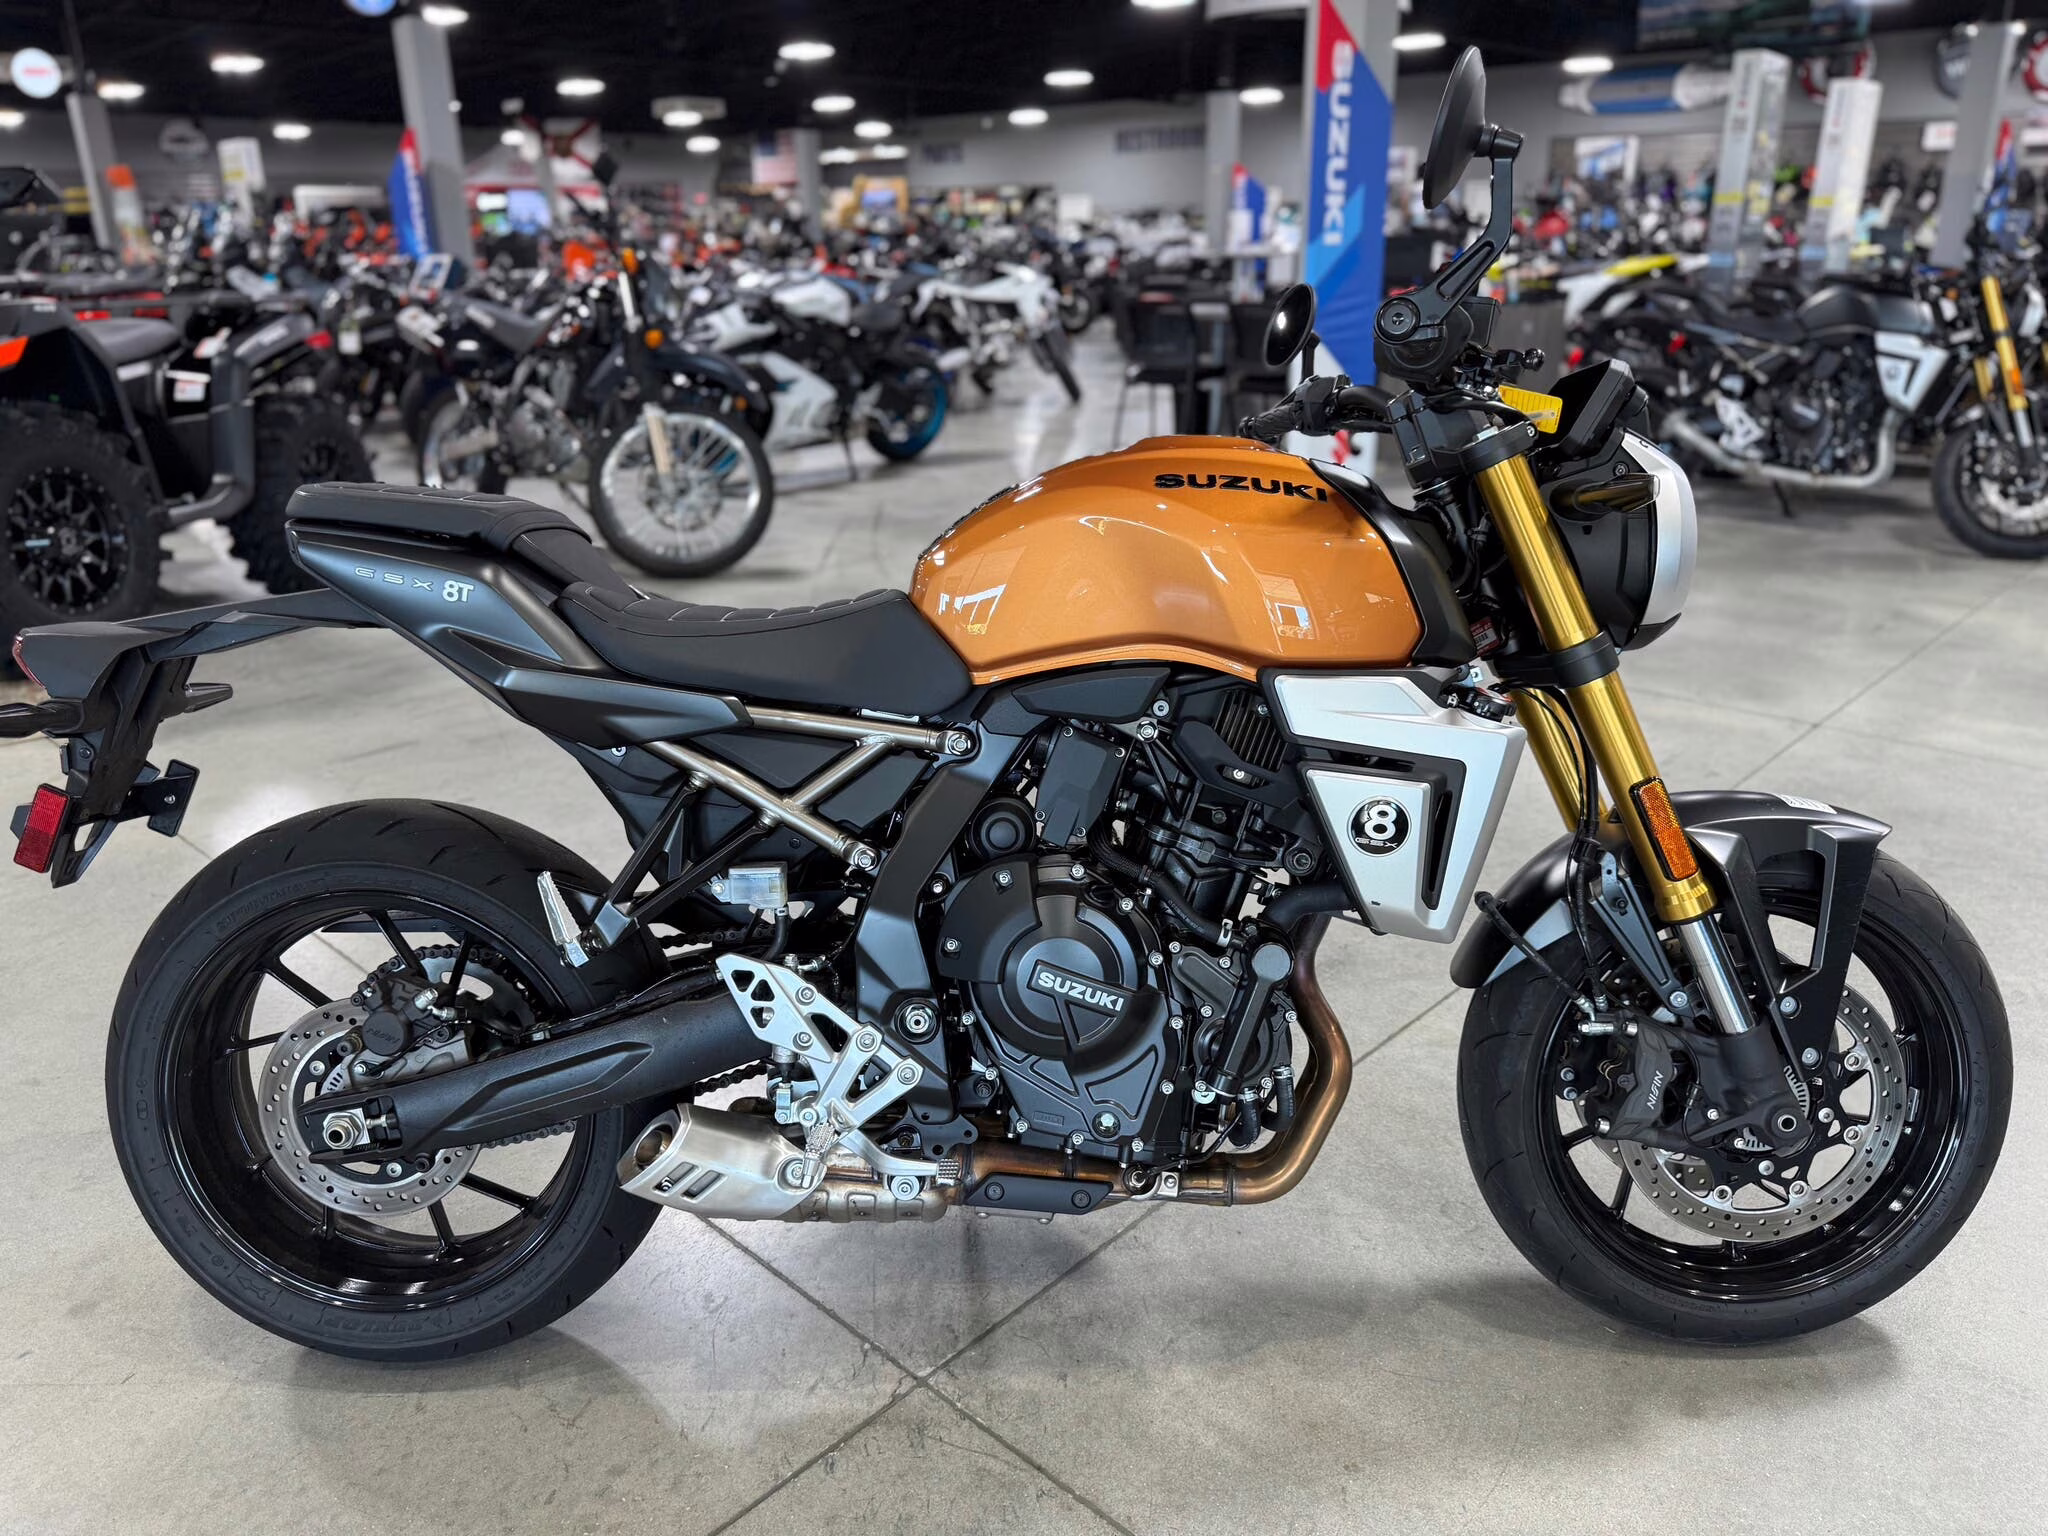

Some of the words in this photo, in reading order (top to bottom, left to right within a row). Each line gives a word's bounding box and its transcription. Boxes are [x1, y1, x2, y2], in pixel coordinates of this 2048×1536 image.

[1323, 39, 1354, 245] SUZUKI
[1154, 473, 1328, 502] SUZUKI
[442, 579, 475, 602] 8T
[1364, 804, 1397, 840] 8
[1037, 971, 1125, 1012] SUZUKI
[1646, 1069, 1664, 1110] NISSIN
